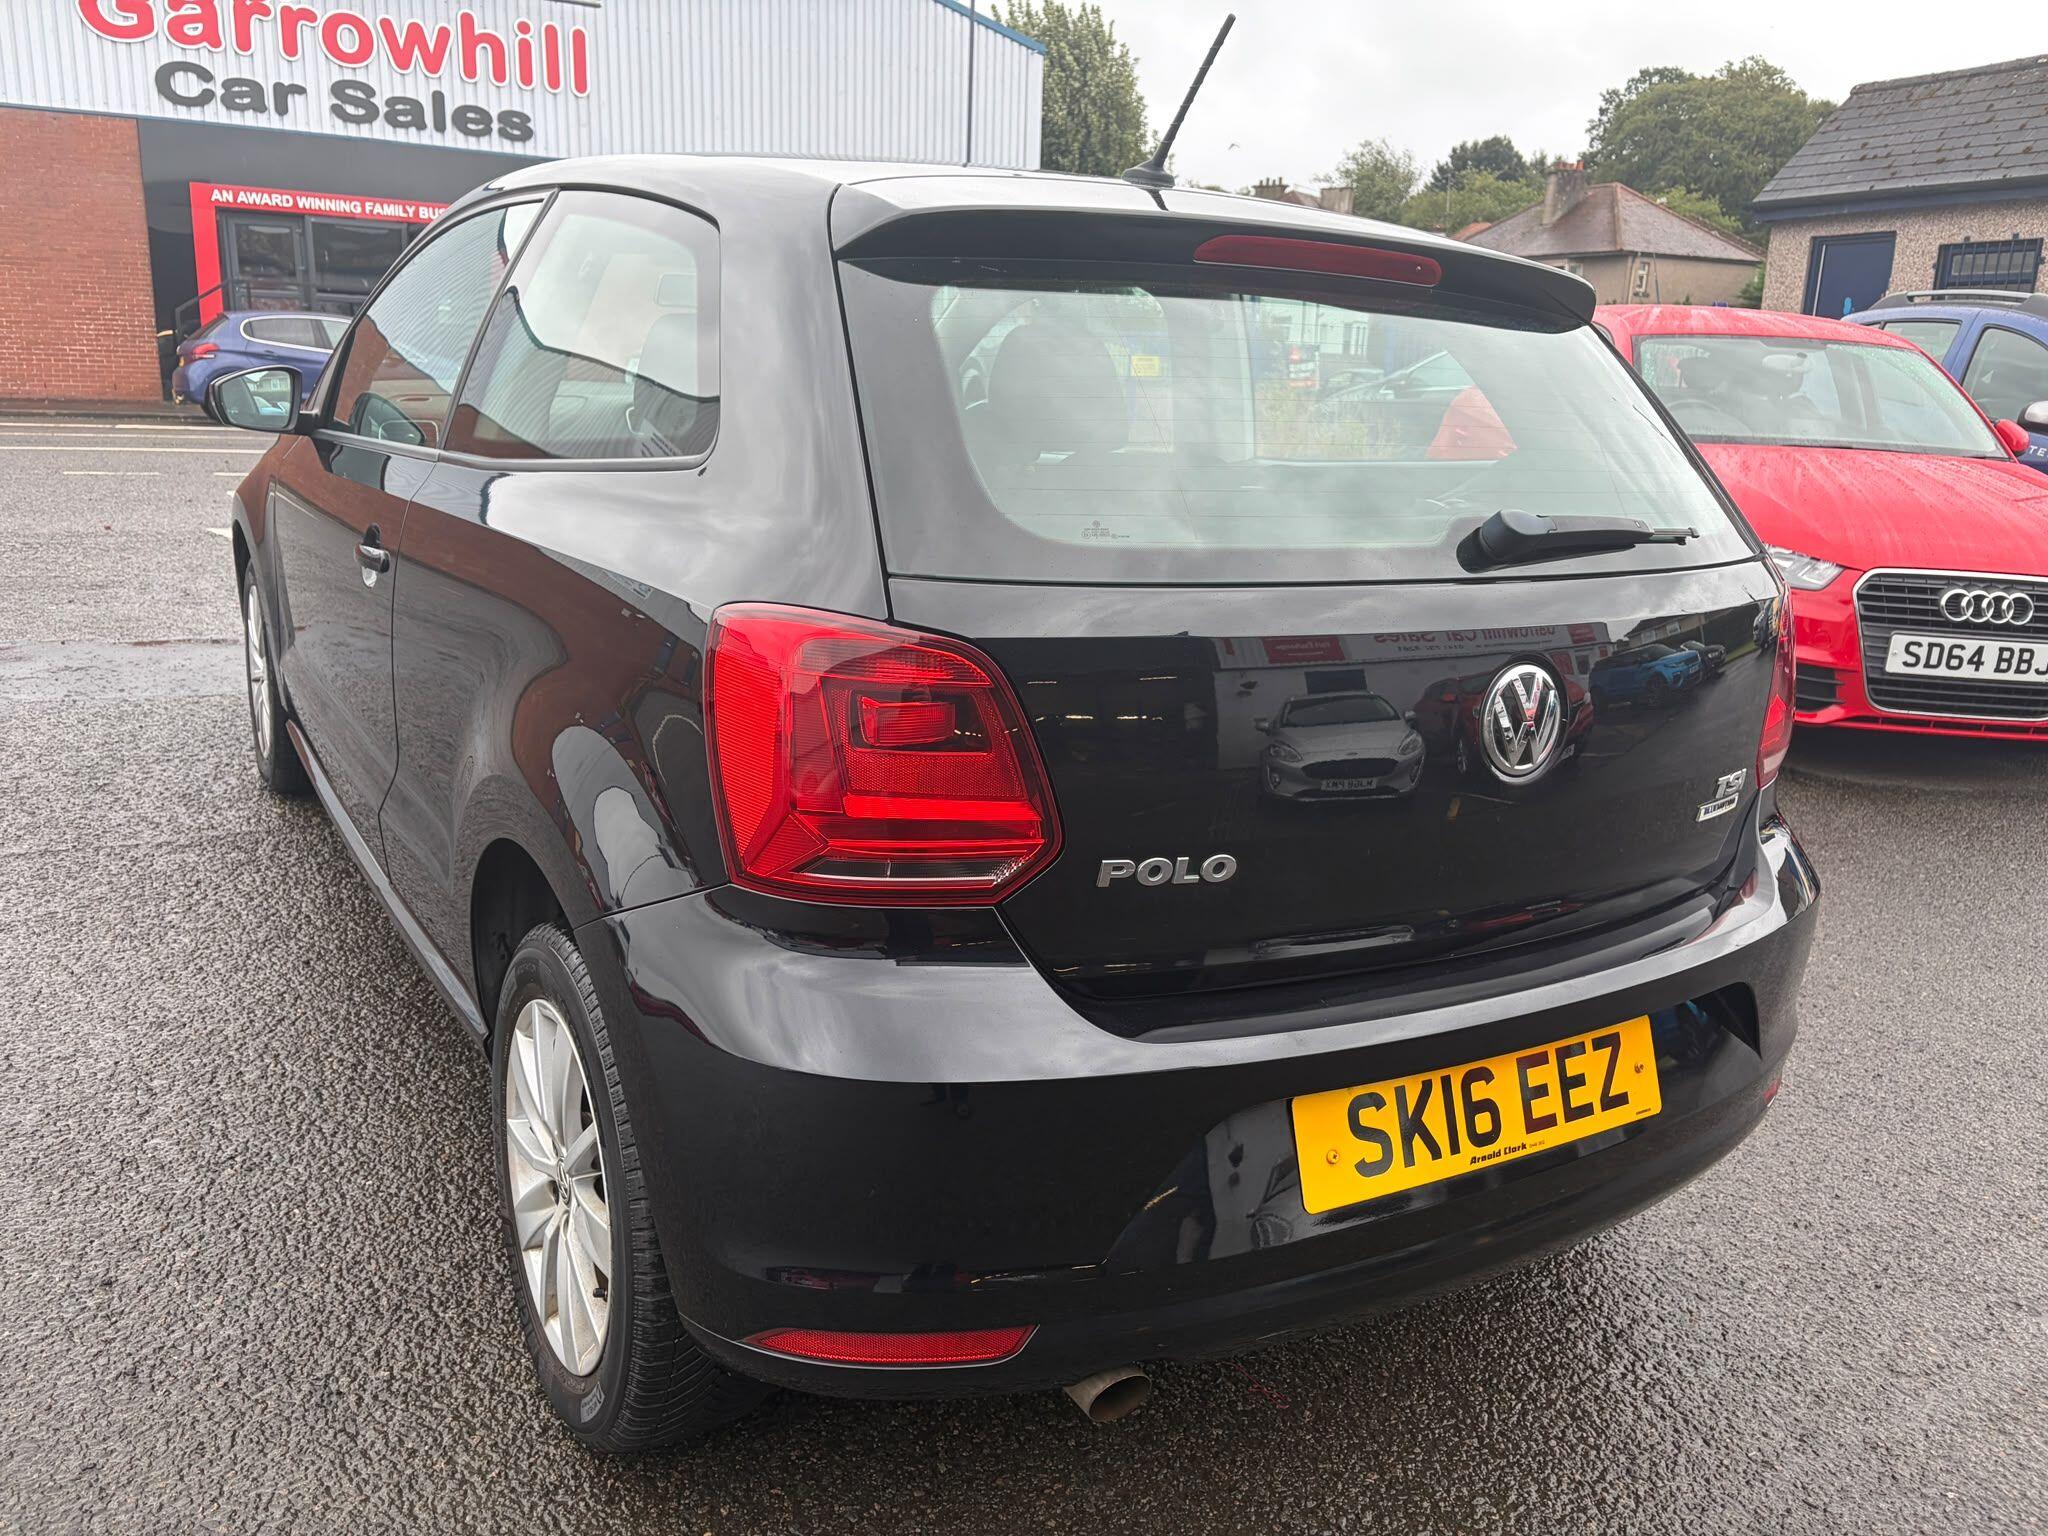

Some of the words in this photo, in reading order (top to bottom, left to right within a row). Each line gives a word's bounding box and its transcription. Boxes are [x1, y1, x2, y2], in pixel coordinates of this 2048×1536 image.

[78, 0, 591, 97] Garrowhill
[155, 61, 306, 116] Car
[330, 79, 534, 143] Sales
[211, 189, 233, 203] AN
[237, 190, 293, 208] AWARD
[296, 195, 361, 214] WINNING
[365, 201, 415, 218] FAMILY
[1902, 640, 1985, 672] SD64
[1096, 854, 1237, 888] POLO
[1347, 1066, 1502, 1179] SK16
[1516, 1031, 1630, 1135] EEZ
[1470, 1149, 1501, 1165] Arnold
[1503, 1142, 1527, 1156] Clark
